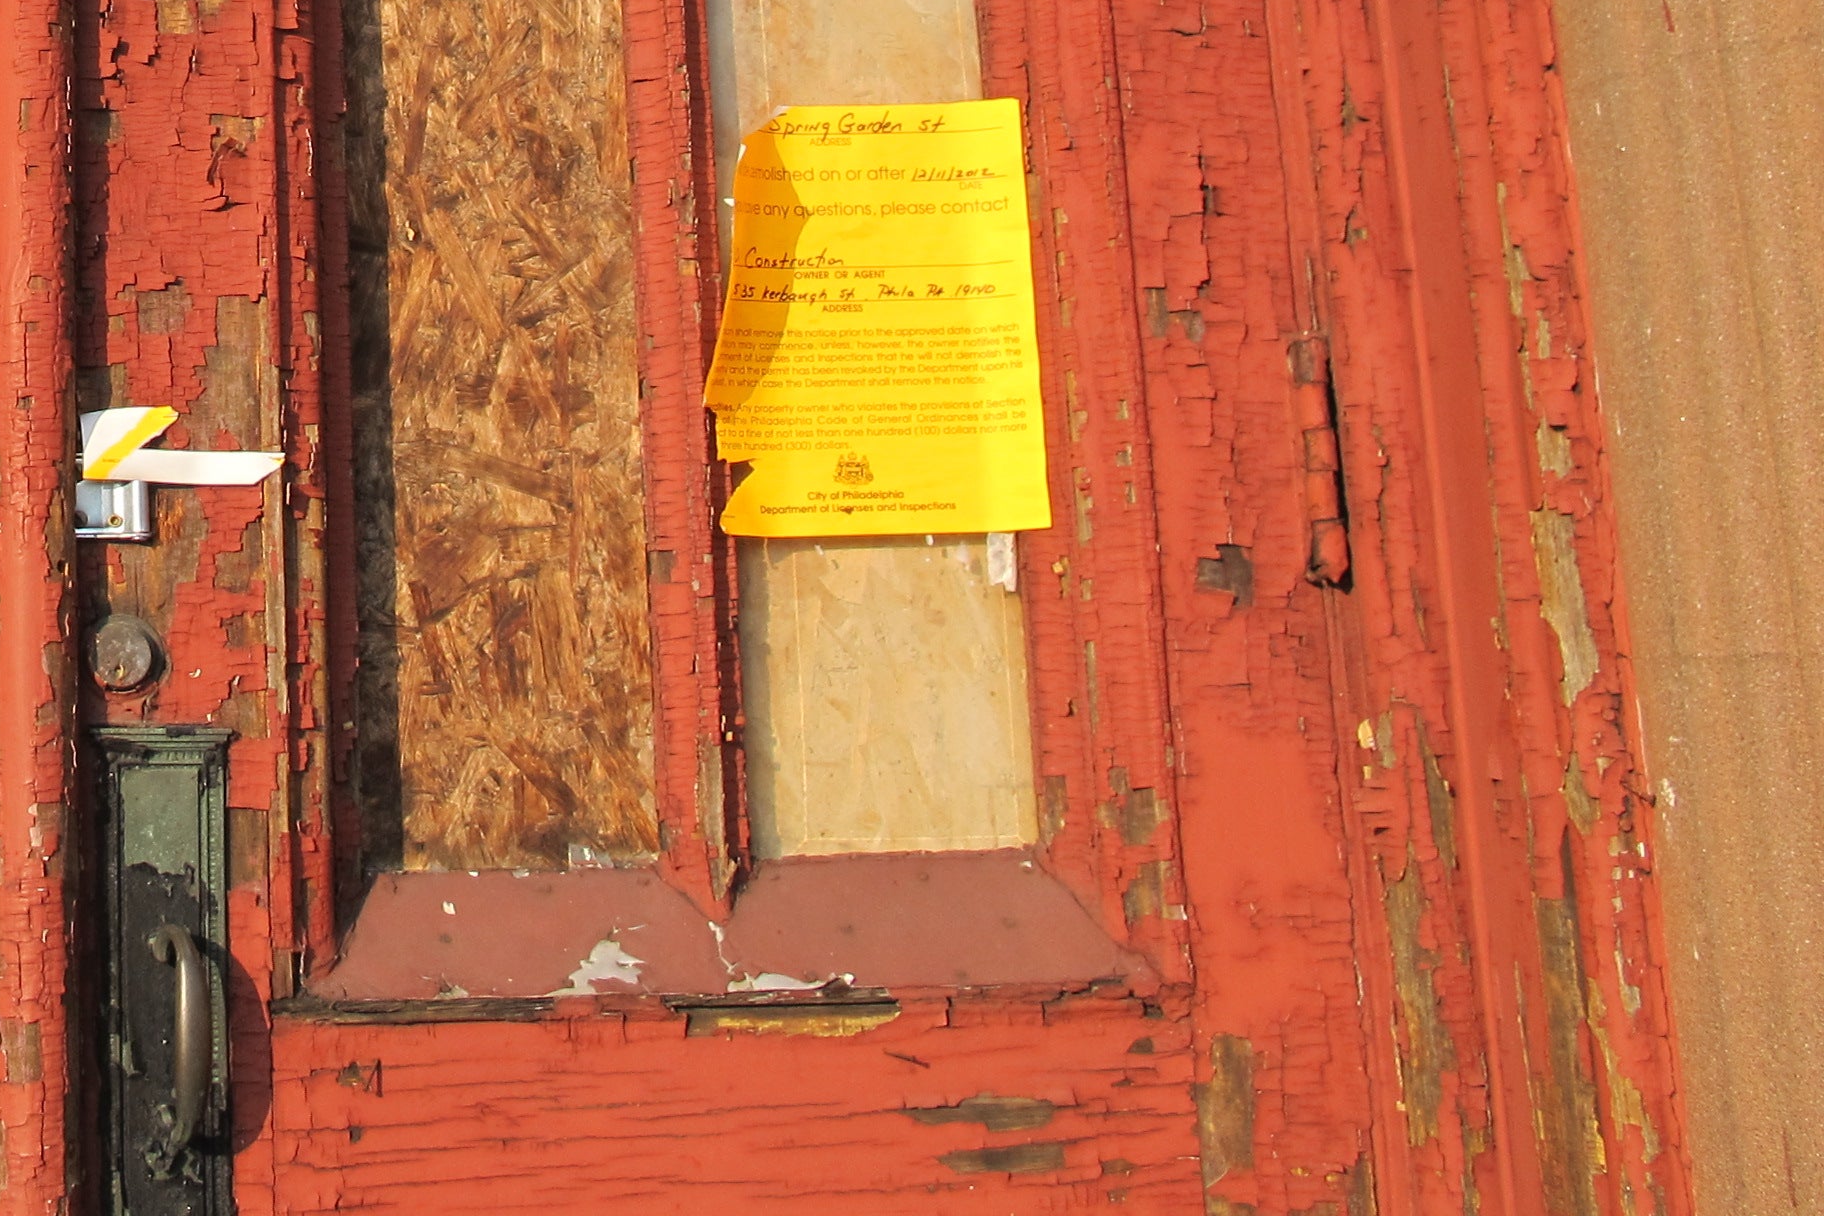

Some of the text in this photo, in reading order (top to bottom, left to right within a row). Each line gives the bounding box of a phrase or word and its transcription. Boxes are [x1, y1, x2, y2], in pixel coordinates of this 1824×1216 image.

[768, 113, 830, 142] Spring
[838, 110, 902, 134] Garden
[819, 169, 841, 182] on
[845, 169, 863, 182] or
[866, 166, 906, 181] after
[763, 204, 790, 218] any
[793, 202, 877, 219] questions,
[880, 201, 936, 218] please
[940, 196, 1009, 214] contact
[794, 270, 885, 279] OWNER OR AGENT
[822, 303, 864, 313] ADDRESS
[786, 329, 804, 338] this
[805, 329, 838, 338] notice
[839, 328, 862, 339] prior
[863, 327, 874, 337] to
[876, 327, 893, 336] the
[895, 326, 945, 338] approved
[947, 325, 971, 335] date
[973, 326, 988, 335] on
[989, 323, 1020, 334] which
[907, 339, 925, 349] the
[927, 340, 960, 349] owner
[963, 338, 1000, 348] notifies
[1003, 336, 1021, 345] the
[754, 404, 794, 414] property
[796, 404, 829, 412] owner
[831, 402, 855, 412] who
[857, 401, 898, 411] violates
[900, 400, 918, 411] the
[919, 400, 971, 411] provisions
[973, 400, 984, 409] of
[985, 397, 1025, 408] Section
[744, 441, 783, 451] hundred
[807, 489, 905, 501] City of Philadelphia
[759, 504, 818, 514] Department
[820, 504, 829, 513] of
[876, 502, 897, 513] and
[898, 500, 956, 512] Inspections
